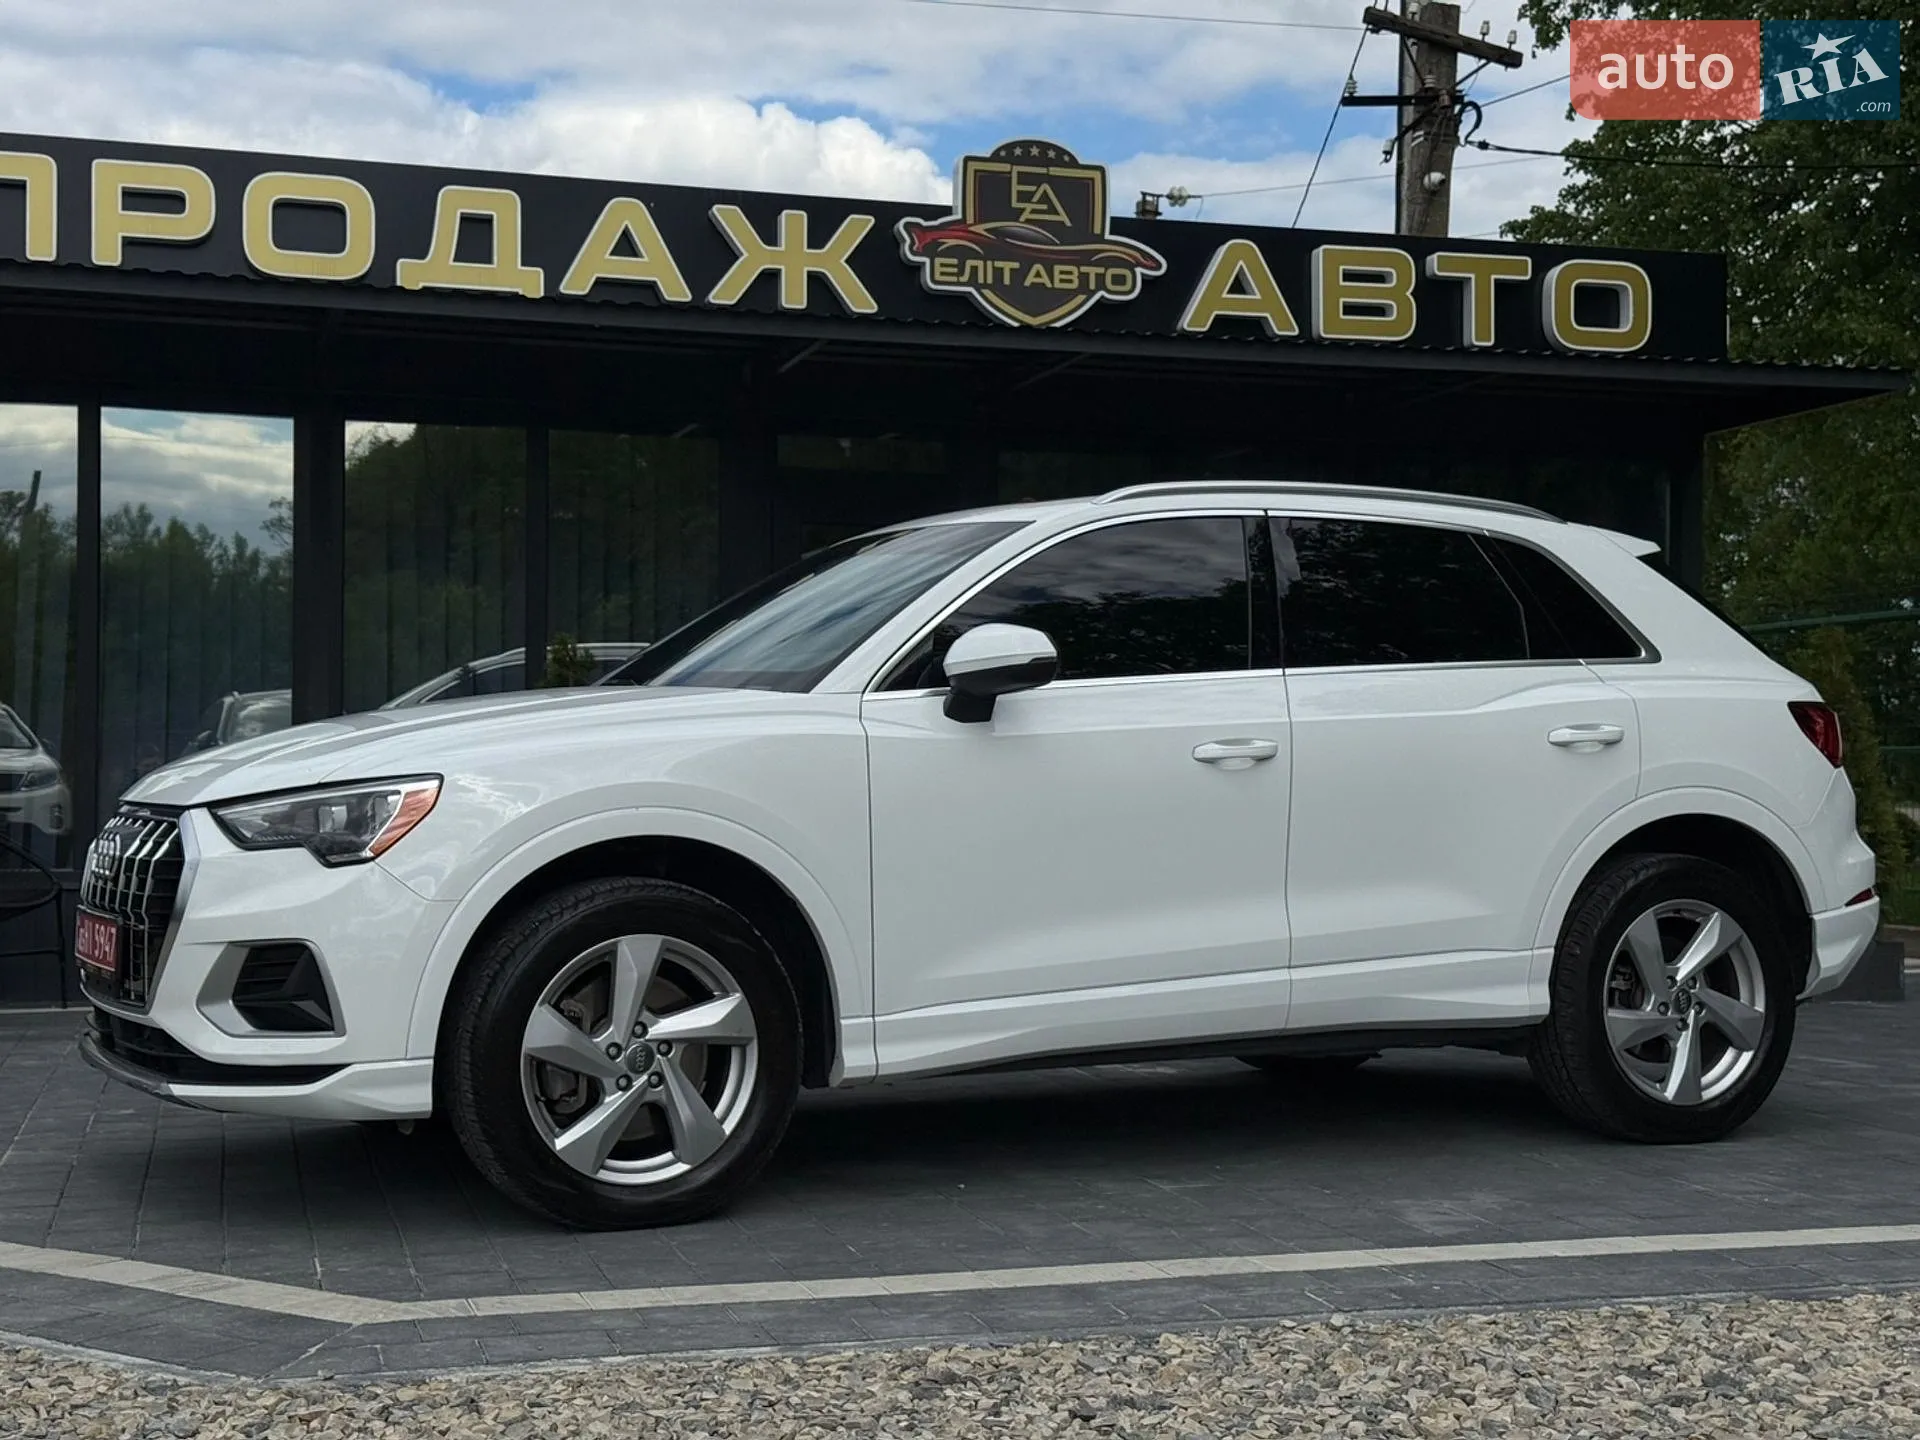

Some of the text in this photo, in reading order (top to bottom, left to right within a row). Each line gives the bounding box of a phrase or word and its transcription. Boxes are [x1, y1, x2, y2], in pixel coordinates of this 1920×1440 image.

[934, 257, 1133, 292] ЕЛІТ АВТО
[1180, 239, 1653, 353] АВТО
